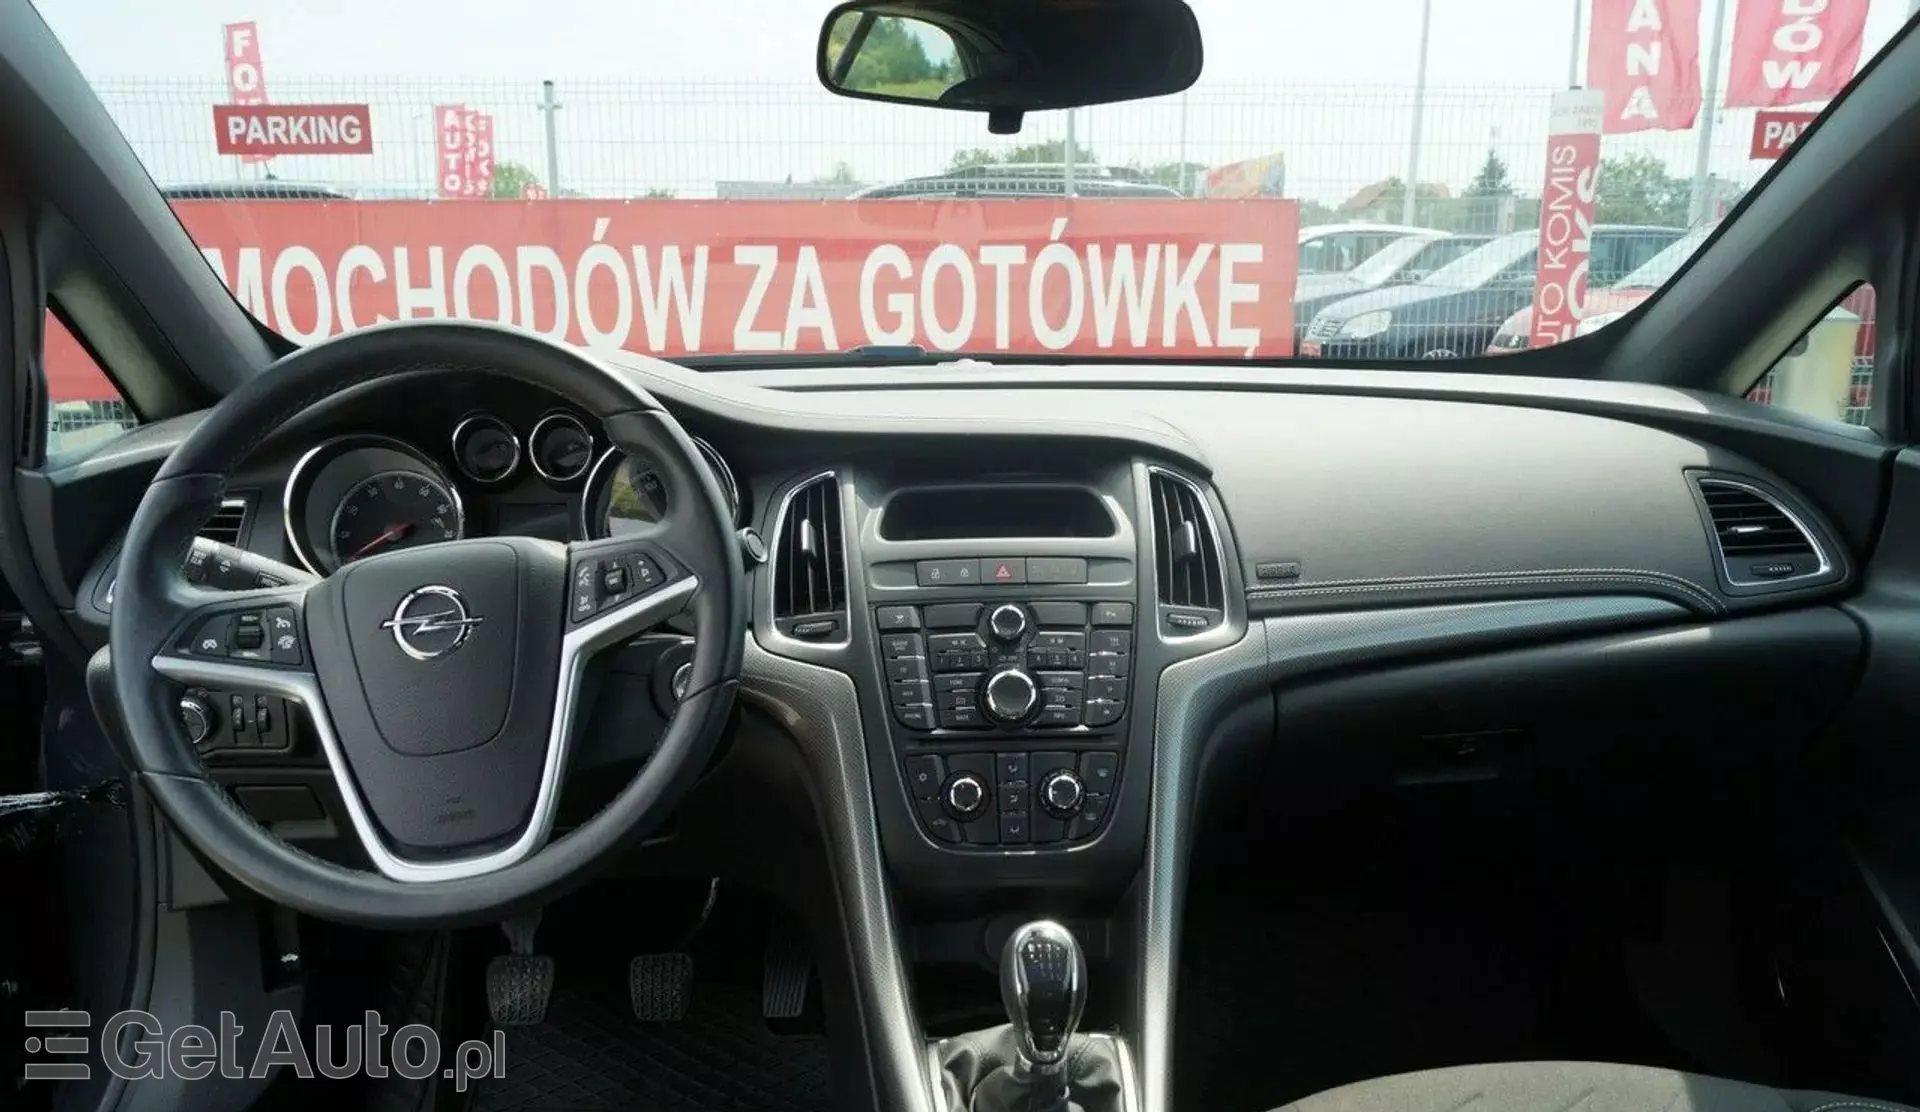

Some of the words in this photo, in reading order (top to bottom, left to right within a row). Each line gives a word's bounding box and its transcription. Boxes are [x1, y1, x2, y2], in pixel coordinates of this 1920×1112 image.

[232, 29, 262, 105] FO
[227, 115, 362, 145] PARKING
[444, 109, 461, 191] AUTO
[1544, 145, 1577, 269] KOMIS
[733, 245, 839, 351] ZA
[859, 218, 1263, 359] GOTÓWKĘ
[1537, 283, 1564, 343] UTO
